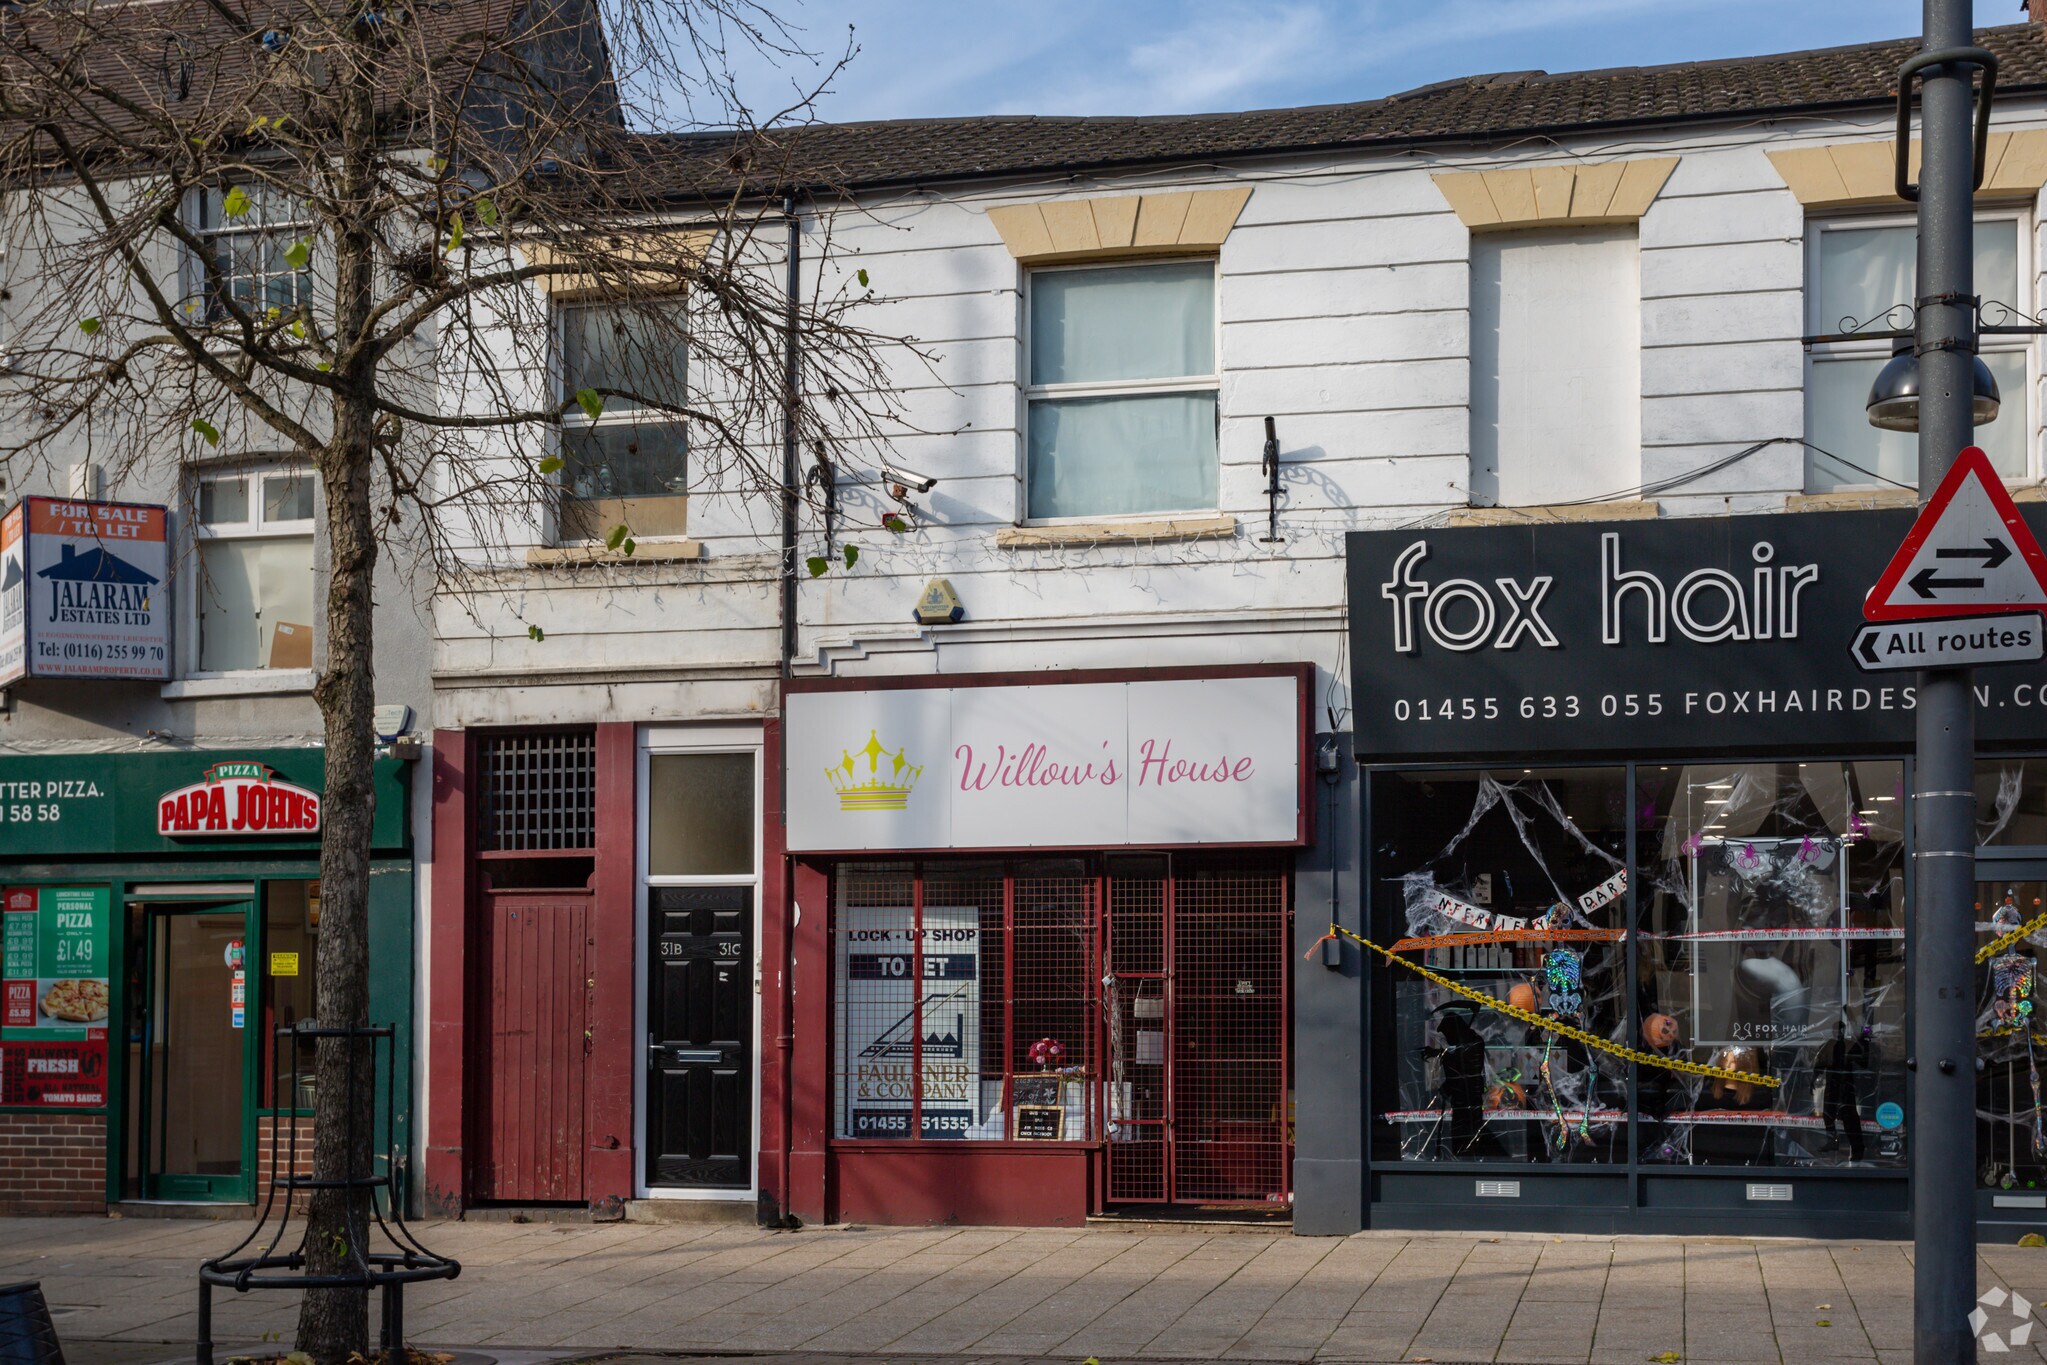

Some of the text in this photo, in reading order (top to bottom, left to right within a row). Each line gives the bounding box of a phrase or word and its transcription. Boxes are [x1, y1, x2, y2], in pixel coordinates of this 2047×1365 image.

[49, 503, 148, 522] FOR SALE
[71, 521, 98, 535] TO
[105, 523, 140, 537] LET
[1381, 532, 1819, 652] fox hair
[49, 580, 150, 622] JALARAM
[60, 609, 151, 625] ESTATES LTD
[1886, 626, 2032, 655] All routes
[38, 641, 60, 657] Tel:
[64, 642, 103, 661] (0116)
[106, 644, 128, 659] 255
[132, 645, 146, 660] 99
[151, 646, 164, 661] 70
[1394, 697, 1500, 721] 01455
[1519, 695, 1581, 719] 633
[1600, 693, 1664, 717] 055
[218, 764, 260, 777] PIZZA
[954, 738, 1256, 791] Willow's House
[46, 781, 105, 798] PIZZA.
[10, 805, 32, 822] 58
[37, 804, 60, 821] 58
[161, 784, 318, 832] PAPA JOHN'S
[57, 902, 93, 911] PERSONAL
[57, 913, 93, 928] PIZZA
[848, 930, 891, 942] LOCK
[932, 929, 976, 941] SHOP
[56, 939, 93, 961] £1.49
[660, 942, 741, 956] 31B 31C
[878, 956, 906, 977] TO
[8, 986, 31, 1000] PIZZA
[8, 1008, 31, 1017] £5.99
[1755, 1024, 1808, 1032] FOX HAIR
[27, 1059, 78, 1073] FRESH
[43, 1093, 102, 1103] TOMATO SAUCE
[857, 1082, 871, 1098] &
[859, 1116, 907, 1130] 01455
